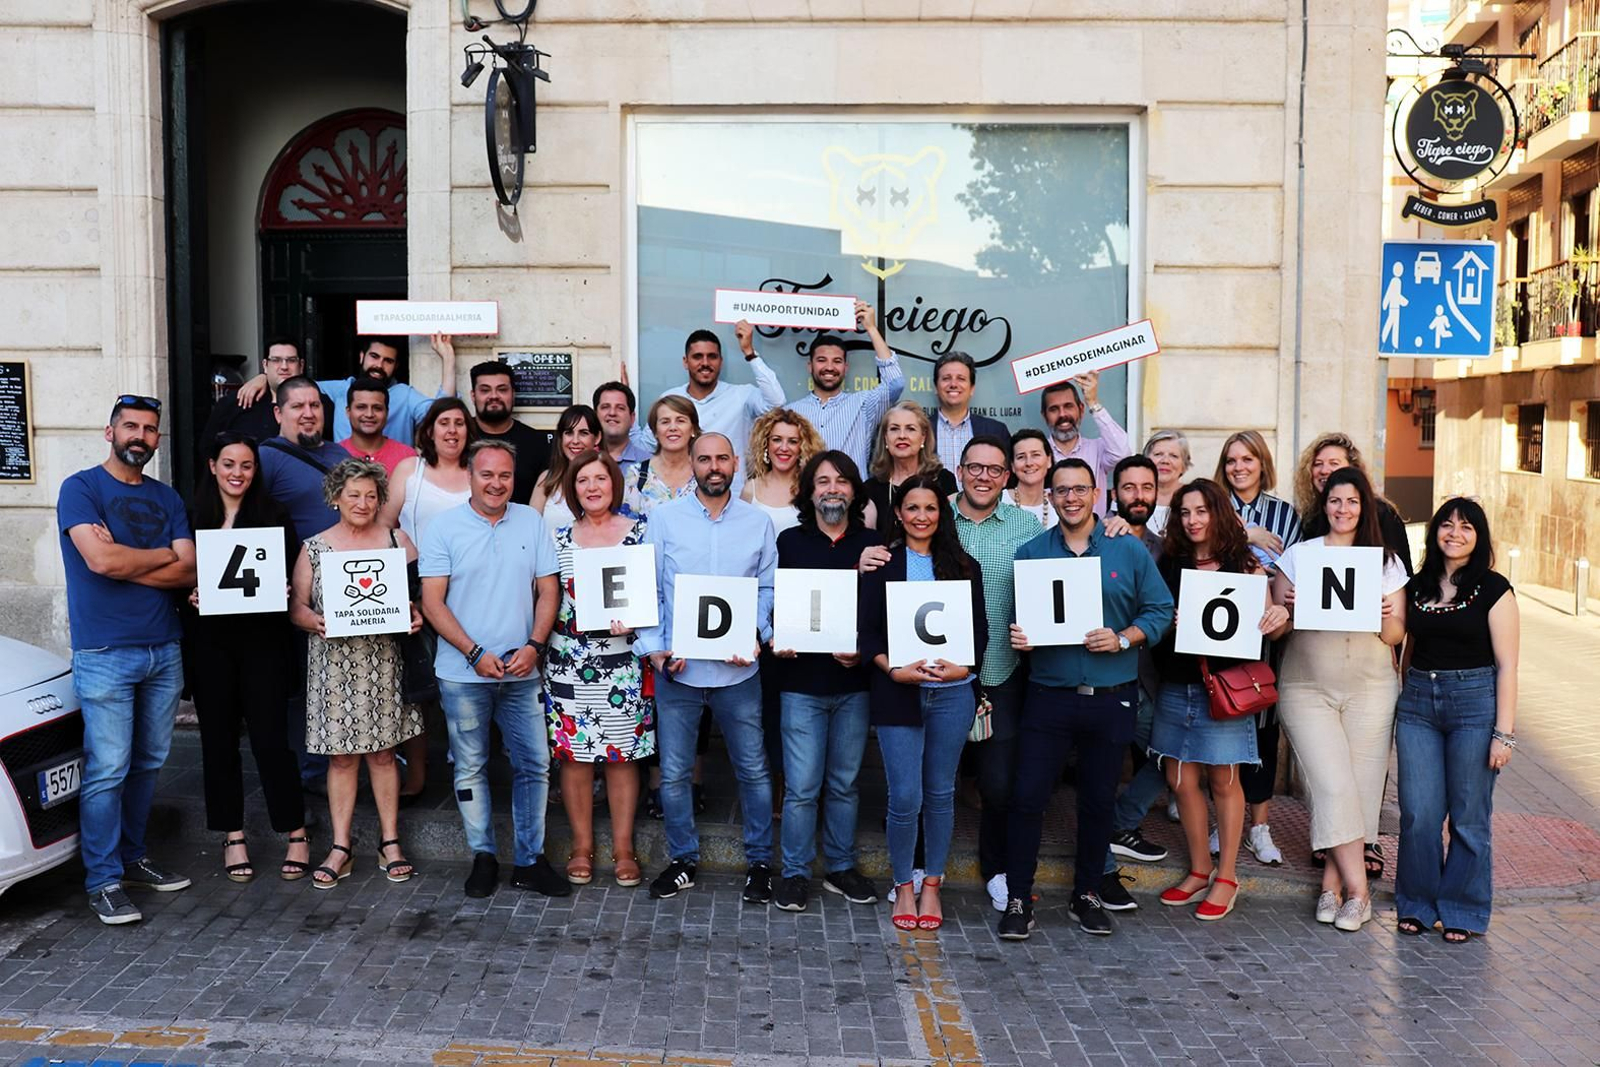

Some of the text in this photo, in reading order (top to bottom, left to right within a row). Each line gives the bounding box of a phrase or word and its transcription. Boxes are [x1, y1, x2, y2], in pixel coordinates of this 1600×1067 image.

[1416, 136, 1494, 164] Tigre ciego
[1438, 210, 1458, 220] COMER
[1464, 206, 1487, 220] CALLAR
[732, 302, 840, 317] #UNAOPORTUNIDAD
[373, 313, 482, 322] #TAPASOLIDARIAALMERIA
[1025, 334, 1146, 378] #DEJEMOSDEIMAGINAR
[854, 376, 880, 391] COM
[989, 407, 998, 417] EL
[1000, 407, 1022, 417] LUGAR
[334, 606, 400, 618] TAPA SOLIDARIA
[350, 616, 386, 626] ALMERIA
